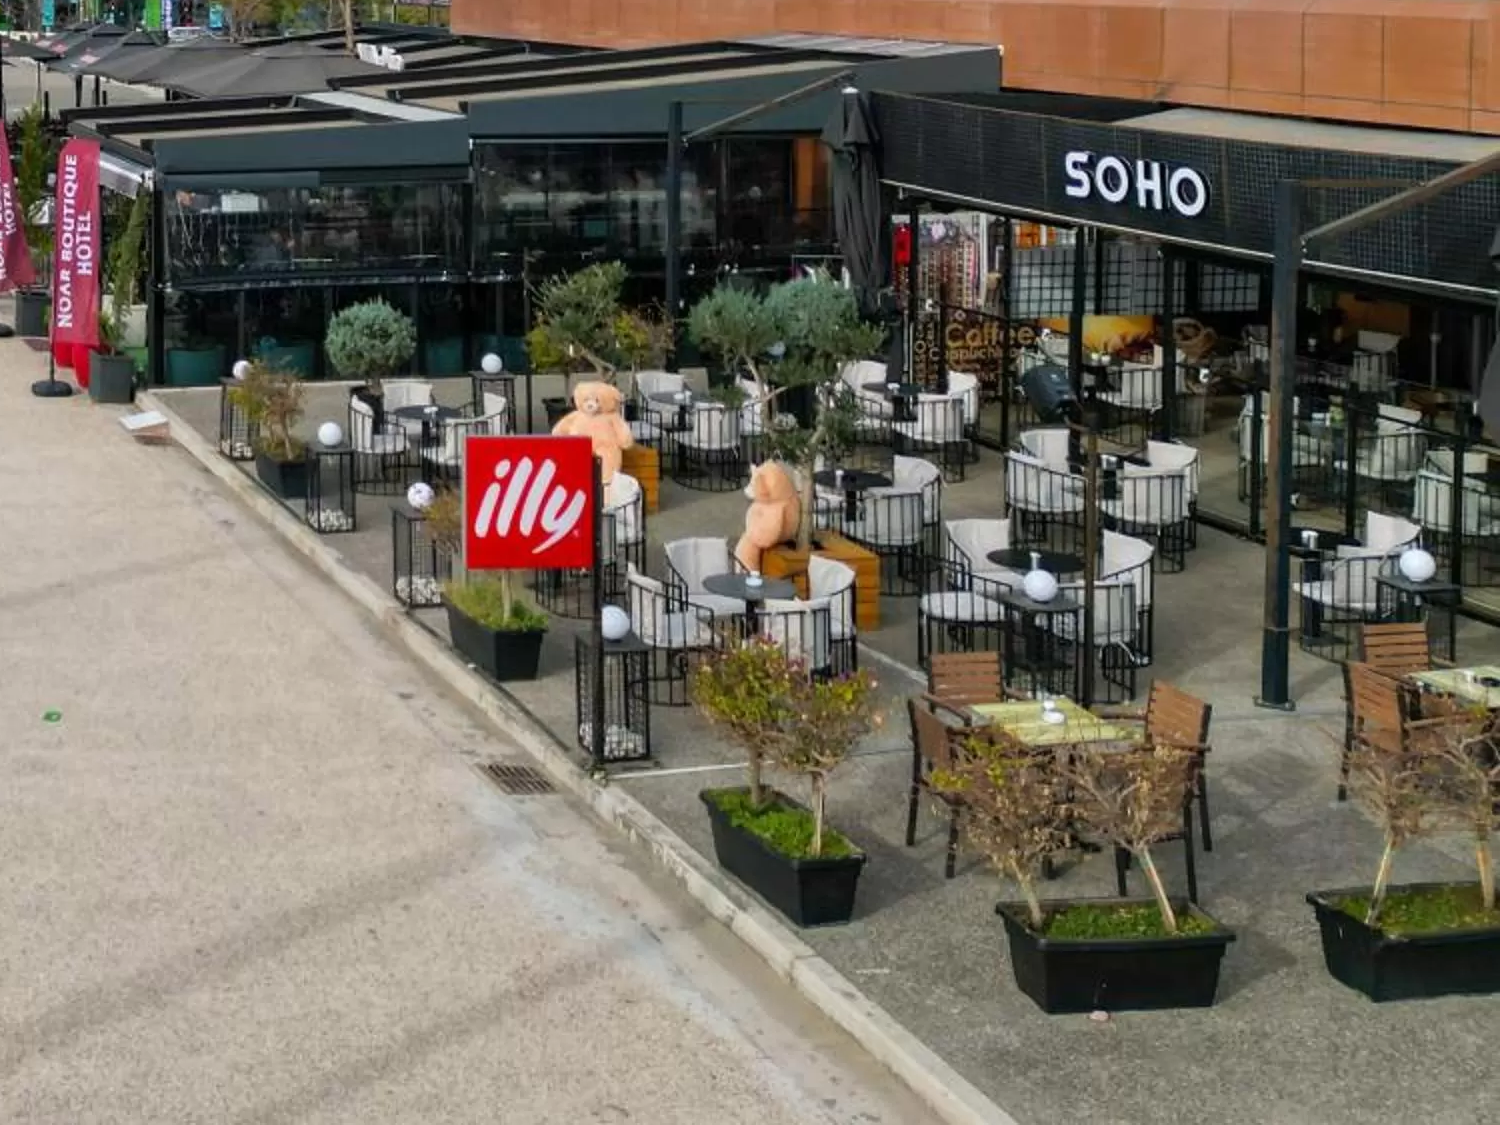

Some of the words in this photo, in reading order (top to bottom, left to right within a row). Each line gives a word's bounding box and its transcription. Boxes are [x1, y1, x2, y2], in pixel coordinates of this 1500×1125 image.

[60, 154, 78, 262] BOUTIQUE
[1065, 151, 1206, 216] SOHO
[75, 211, 93, 276] HOTEL
[57, 269, 73, 328] NOAR
[474, 456, 587, 554] illy
